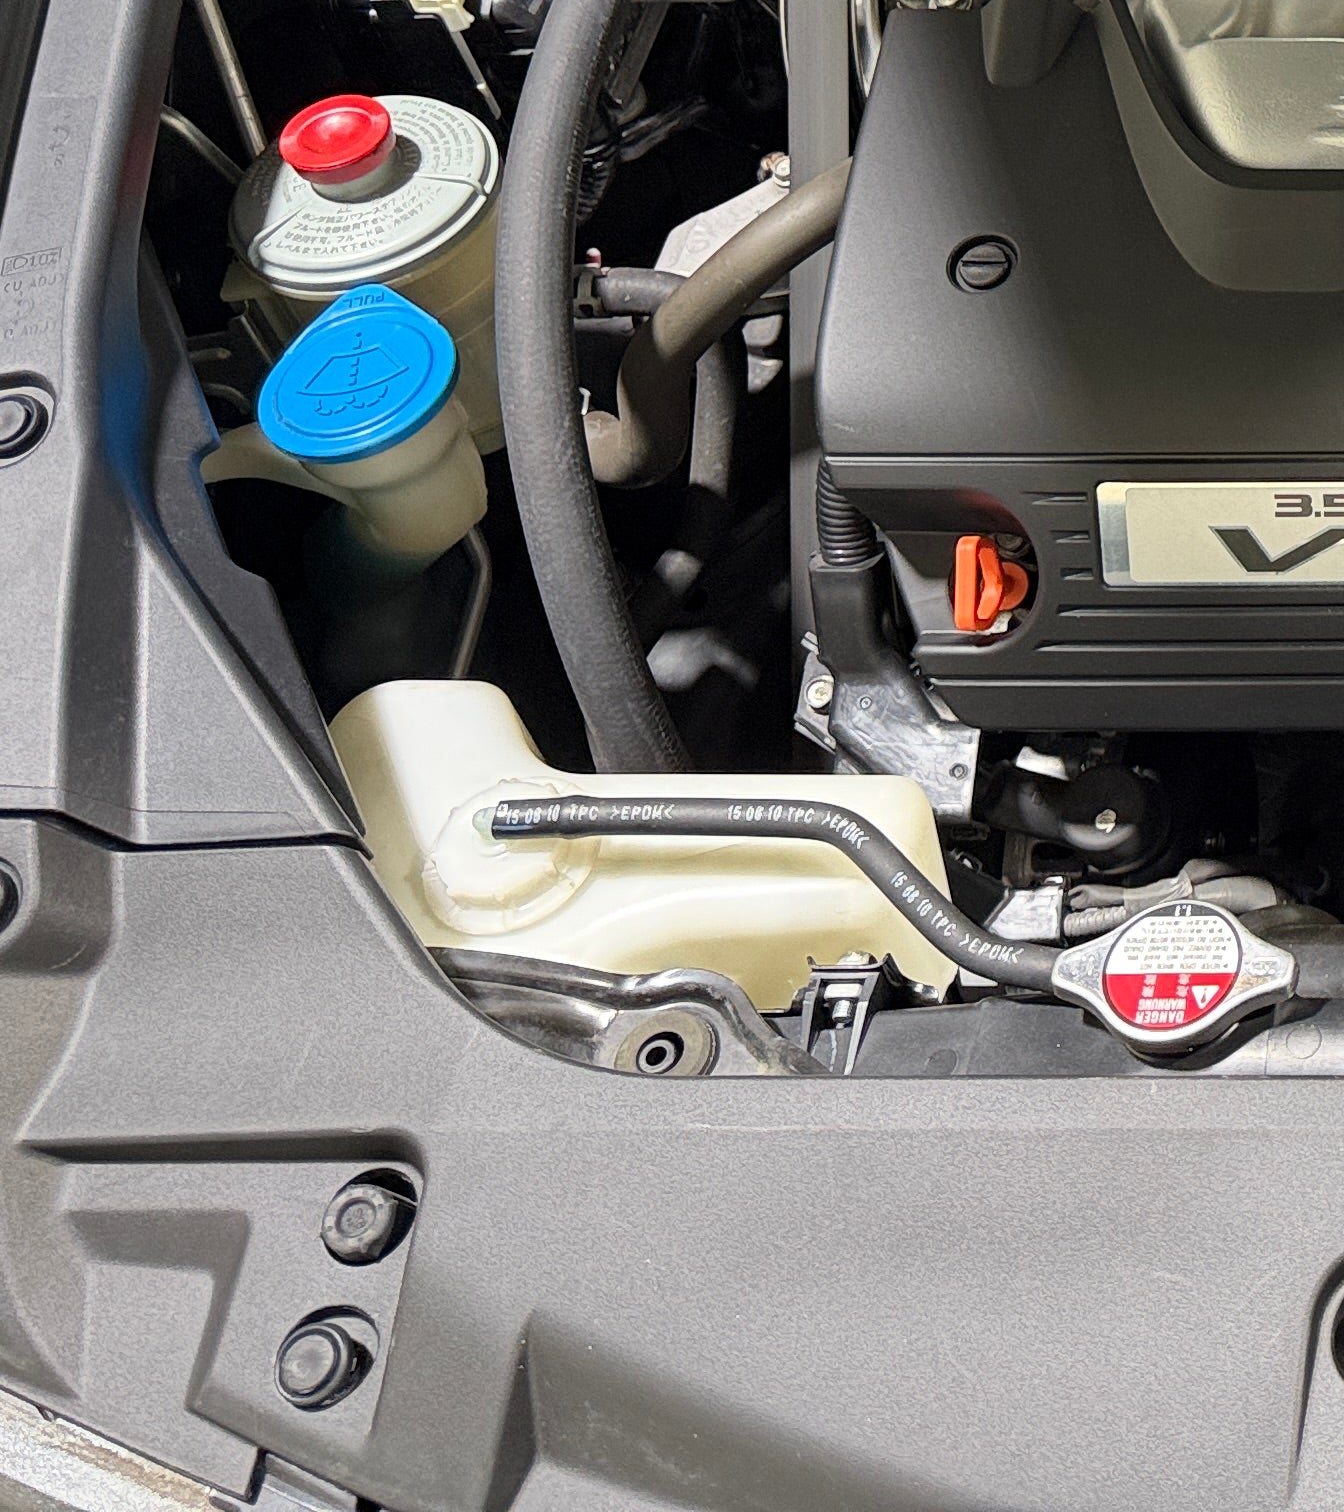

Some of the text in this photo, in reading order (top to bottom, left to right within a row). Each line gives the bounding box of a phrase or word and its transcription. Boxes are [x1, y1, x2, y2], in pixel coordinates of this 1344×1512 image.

[342, 291, 385, 308] PULL
[506, 808, 519, 824] 15
[570, 804, 599, 820] TPC
[728, 805, 742, 821] 15
[767, 805, 783, 821] 10
[787, 806, 815, 824] TPC
[1175, 905, 1192, 917] 1.1
[1138, 998, 1187, 1011] WARNUNG
[1135, 1010, 1185, 1024] DANGER
